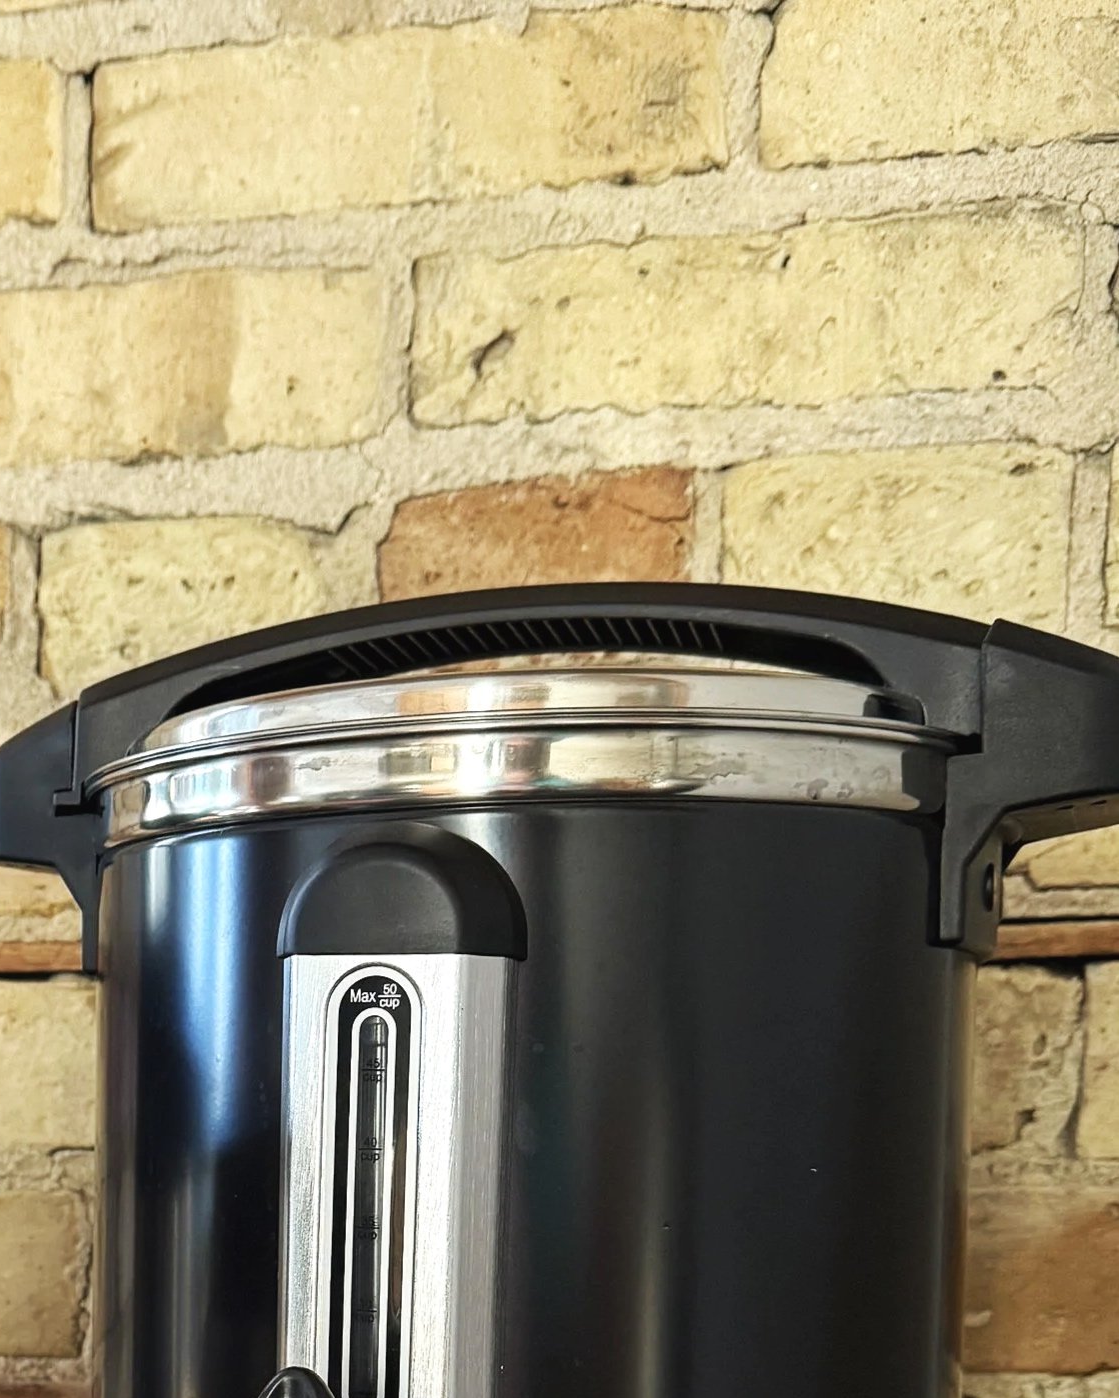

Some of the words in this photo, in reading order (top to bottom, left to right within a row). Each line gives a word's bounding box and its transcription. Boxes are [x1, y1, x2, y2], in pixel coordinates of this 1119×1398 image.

[383, 983, 397, 995] 50
[349, 988, 377, 1003] Max
[379, 998, 400, 1010] cup
[361, 1152, 380, 1164] cup
